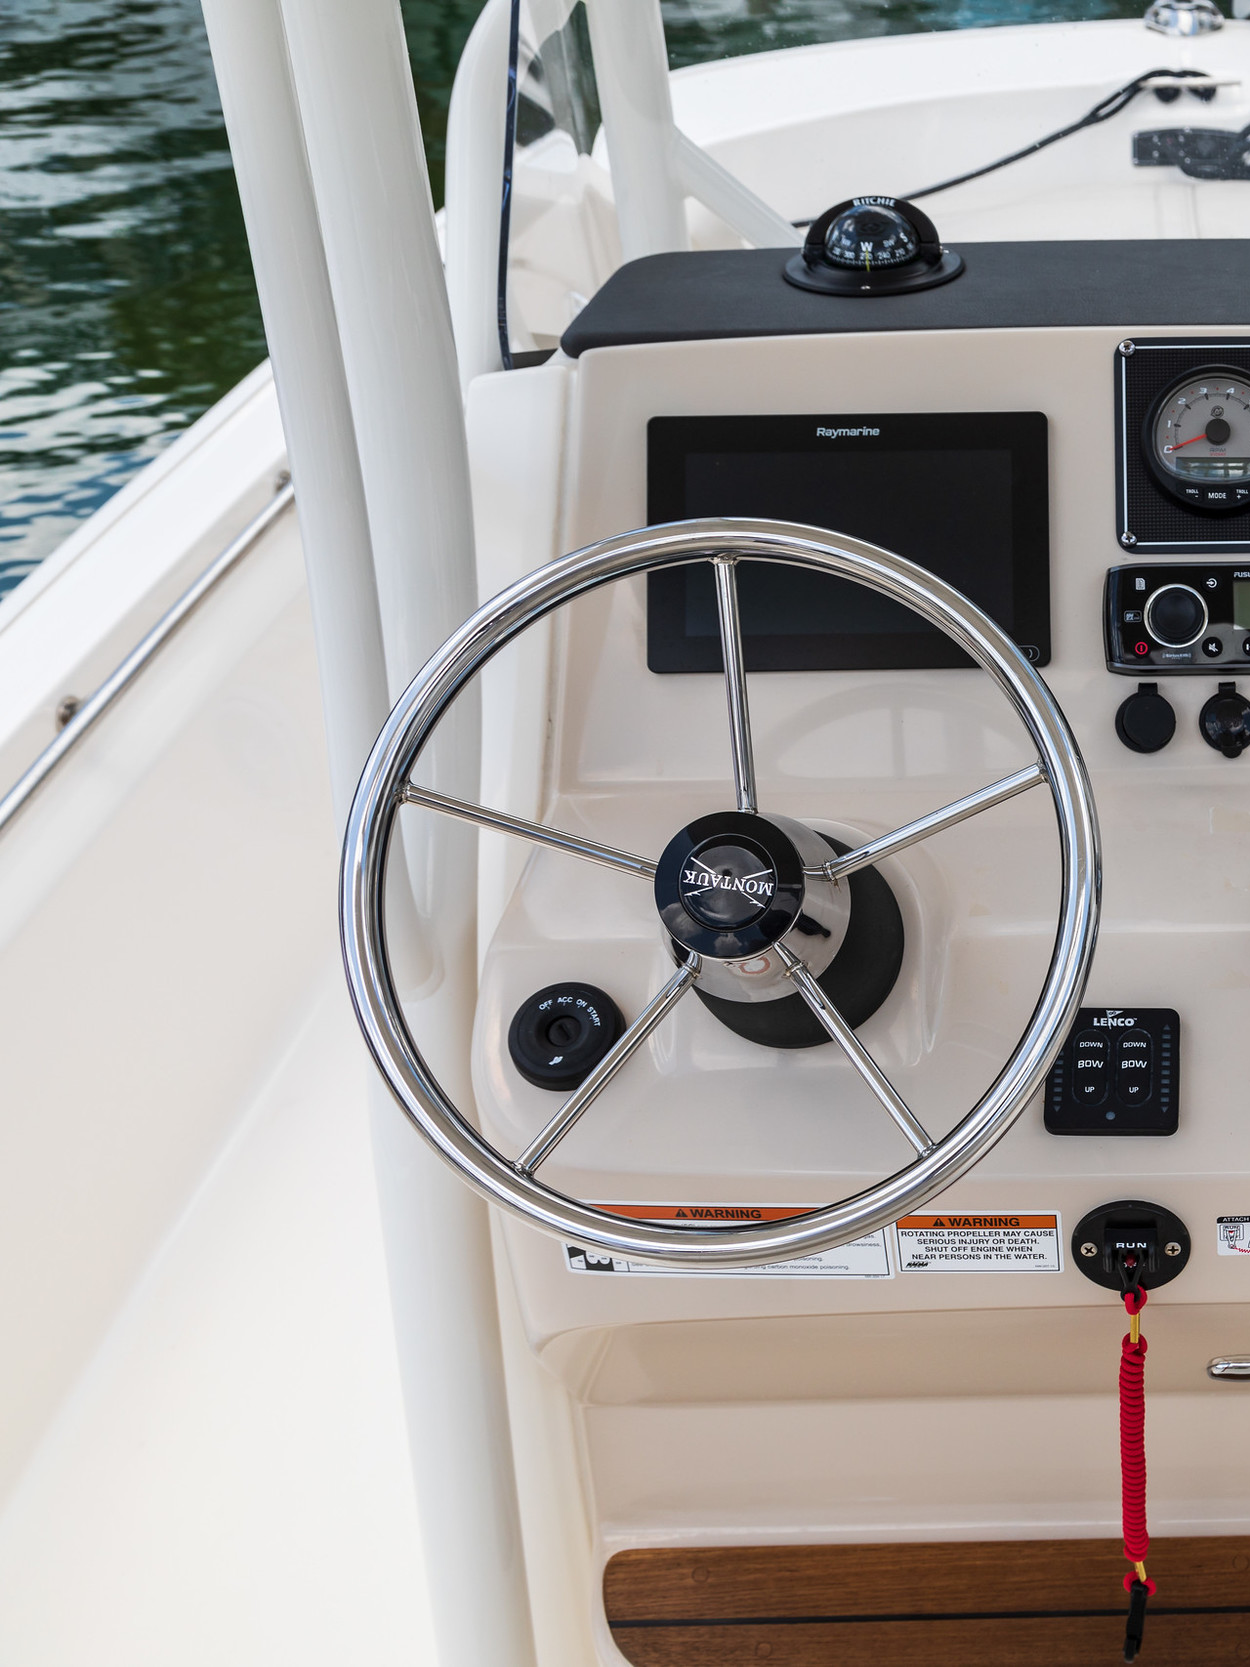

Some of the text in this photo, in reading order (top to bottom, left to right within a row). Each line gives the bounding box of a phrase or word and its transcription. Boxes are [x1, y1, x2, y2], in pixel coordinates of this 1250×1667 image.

[852, 197, 896, 207] RITCHIE
[860, 241, 873, 252] W
[1167, 419, 1172, 428] 1
[816, 426, 880, 439] Raymarine
[683, 869, 774, 896] MONTAUK
[538, 999, 553, 1010] OFF
[576, 999, 588, 1007] ON
[587, 1006, 601, 1026] START
[1093, 1017, 1135, 1027] LENCO
[1077, 1060, 1104, 1069] BOW
[1121, 1060, 1148, 1069] BOW
[1128, 1086, 1140, 1094] UP
[690, 1208, 762, 1219] WARNING
[948, 1217, 1020, 1227] WARNING
[900, 1230, 945, 1238] ROTATING
